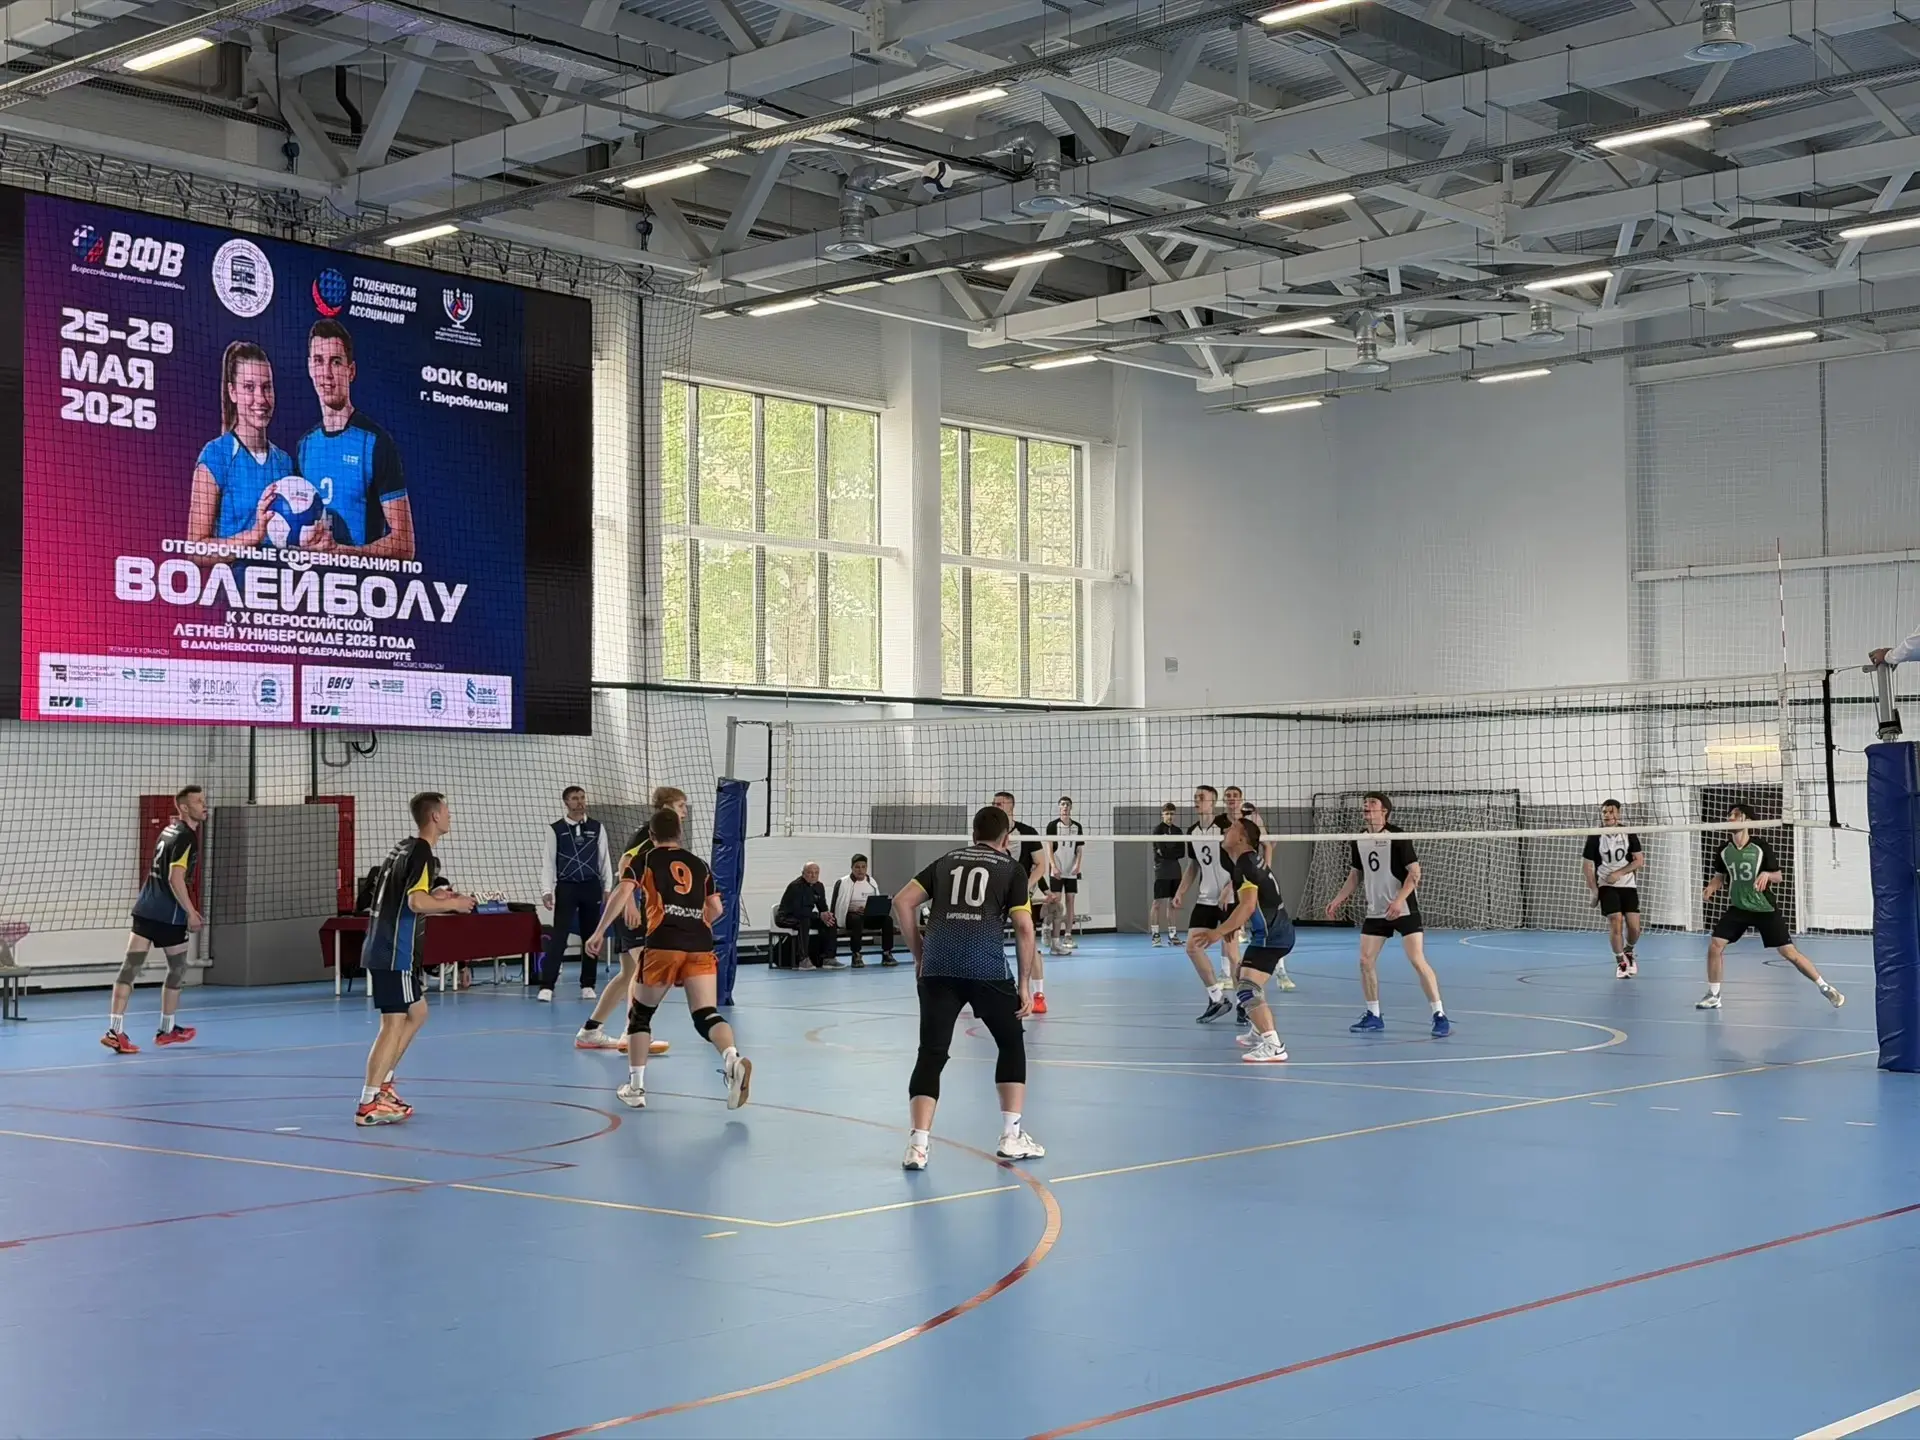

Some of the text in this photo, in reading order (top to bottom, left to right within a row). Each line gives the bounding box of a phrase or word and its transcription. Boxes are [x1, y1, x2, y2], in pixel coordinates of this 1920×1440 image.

[105, 231, 185, 277] ВФВ
[353, 276, 417, 298] СТУДЕНЧЕСКАЯ
[351, 291, 417, 312] ВОЛЕЙБОЛЬНАЯ
[349, 305, 405, 324] АССОЦИАЦИЯ
[60, 307, 173, 354] 25-29
[61, 347, 154, 390] МАЯ
[421, 365, 508, 394] ФОК Воин
[61, 387, 157, 430] 2026
[420, 391, 508, 413] г. Биробиджан
[161, 539, 423, 574] ОТБОРОЧНЫЕ СОРЕВНОВАНИЯ ПО
[115, 555, 469, 623] ВОЛЕЙБОЛУ
[226, 611, 237, 623] К
[253, 612, 374, 633] ВСЕРОССИЙСКОЙ
[173, 623, 416, 649] ЛЕТНЕЙ УНИВЕРСИАДЕ 2026 ГОДА
[181, 639, 412, 661] В ДАЛЬНЕВОСТОЧНОМ ФЕДЕРАЛЬНОМ ОКРУГЕ
[1202, 845, 1212, 866] 3
[1368, 851, 1380, 872] 6
[1602, 848, 1625, 863] 10
[670, 860, 693, 895] 9
[1728, 862, 1753, 881] 13
[950, 865, 989, 907] 10
